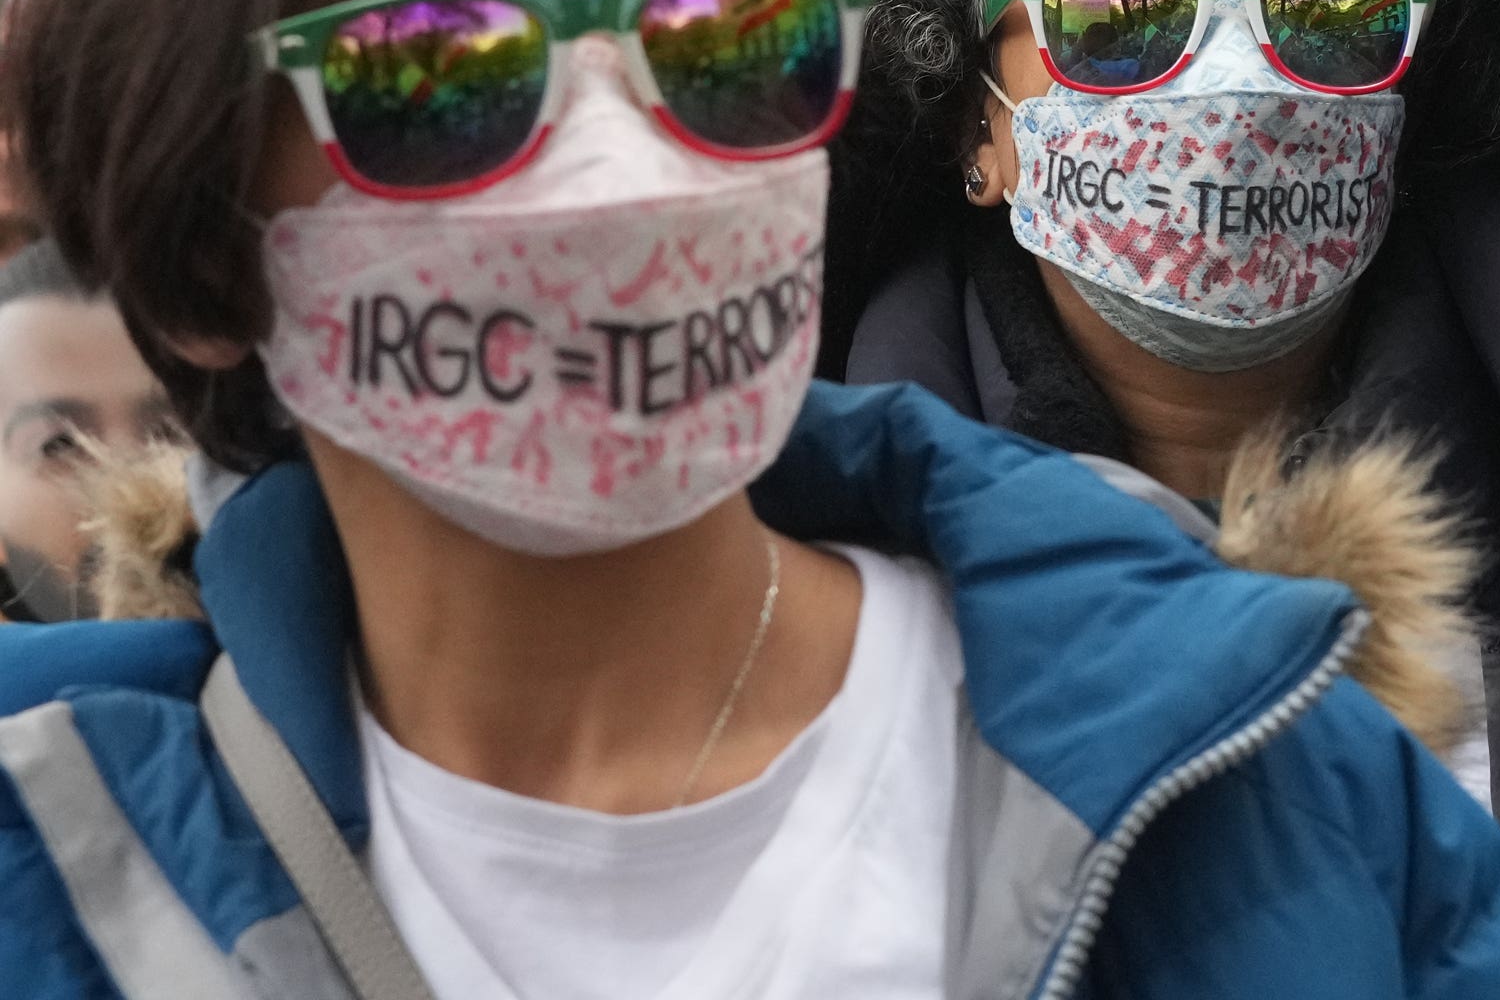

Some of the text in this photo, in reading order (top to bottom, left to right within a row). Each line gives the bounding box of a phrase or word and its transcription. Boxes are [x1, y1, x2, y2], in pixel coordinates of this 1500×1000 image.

[1042, 149, 1127, 214] IRGC
[1189, 169, 1380, 237] TERRORIST
[348, 294, 535, 403] IRGC
